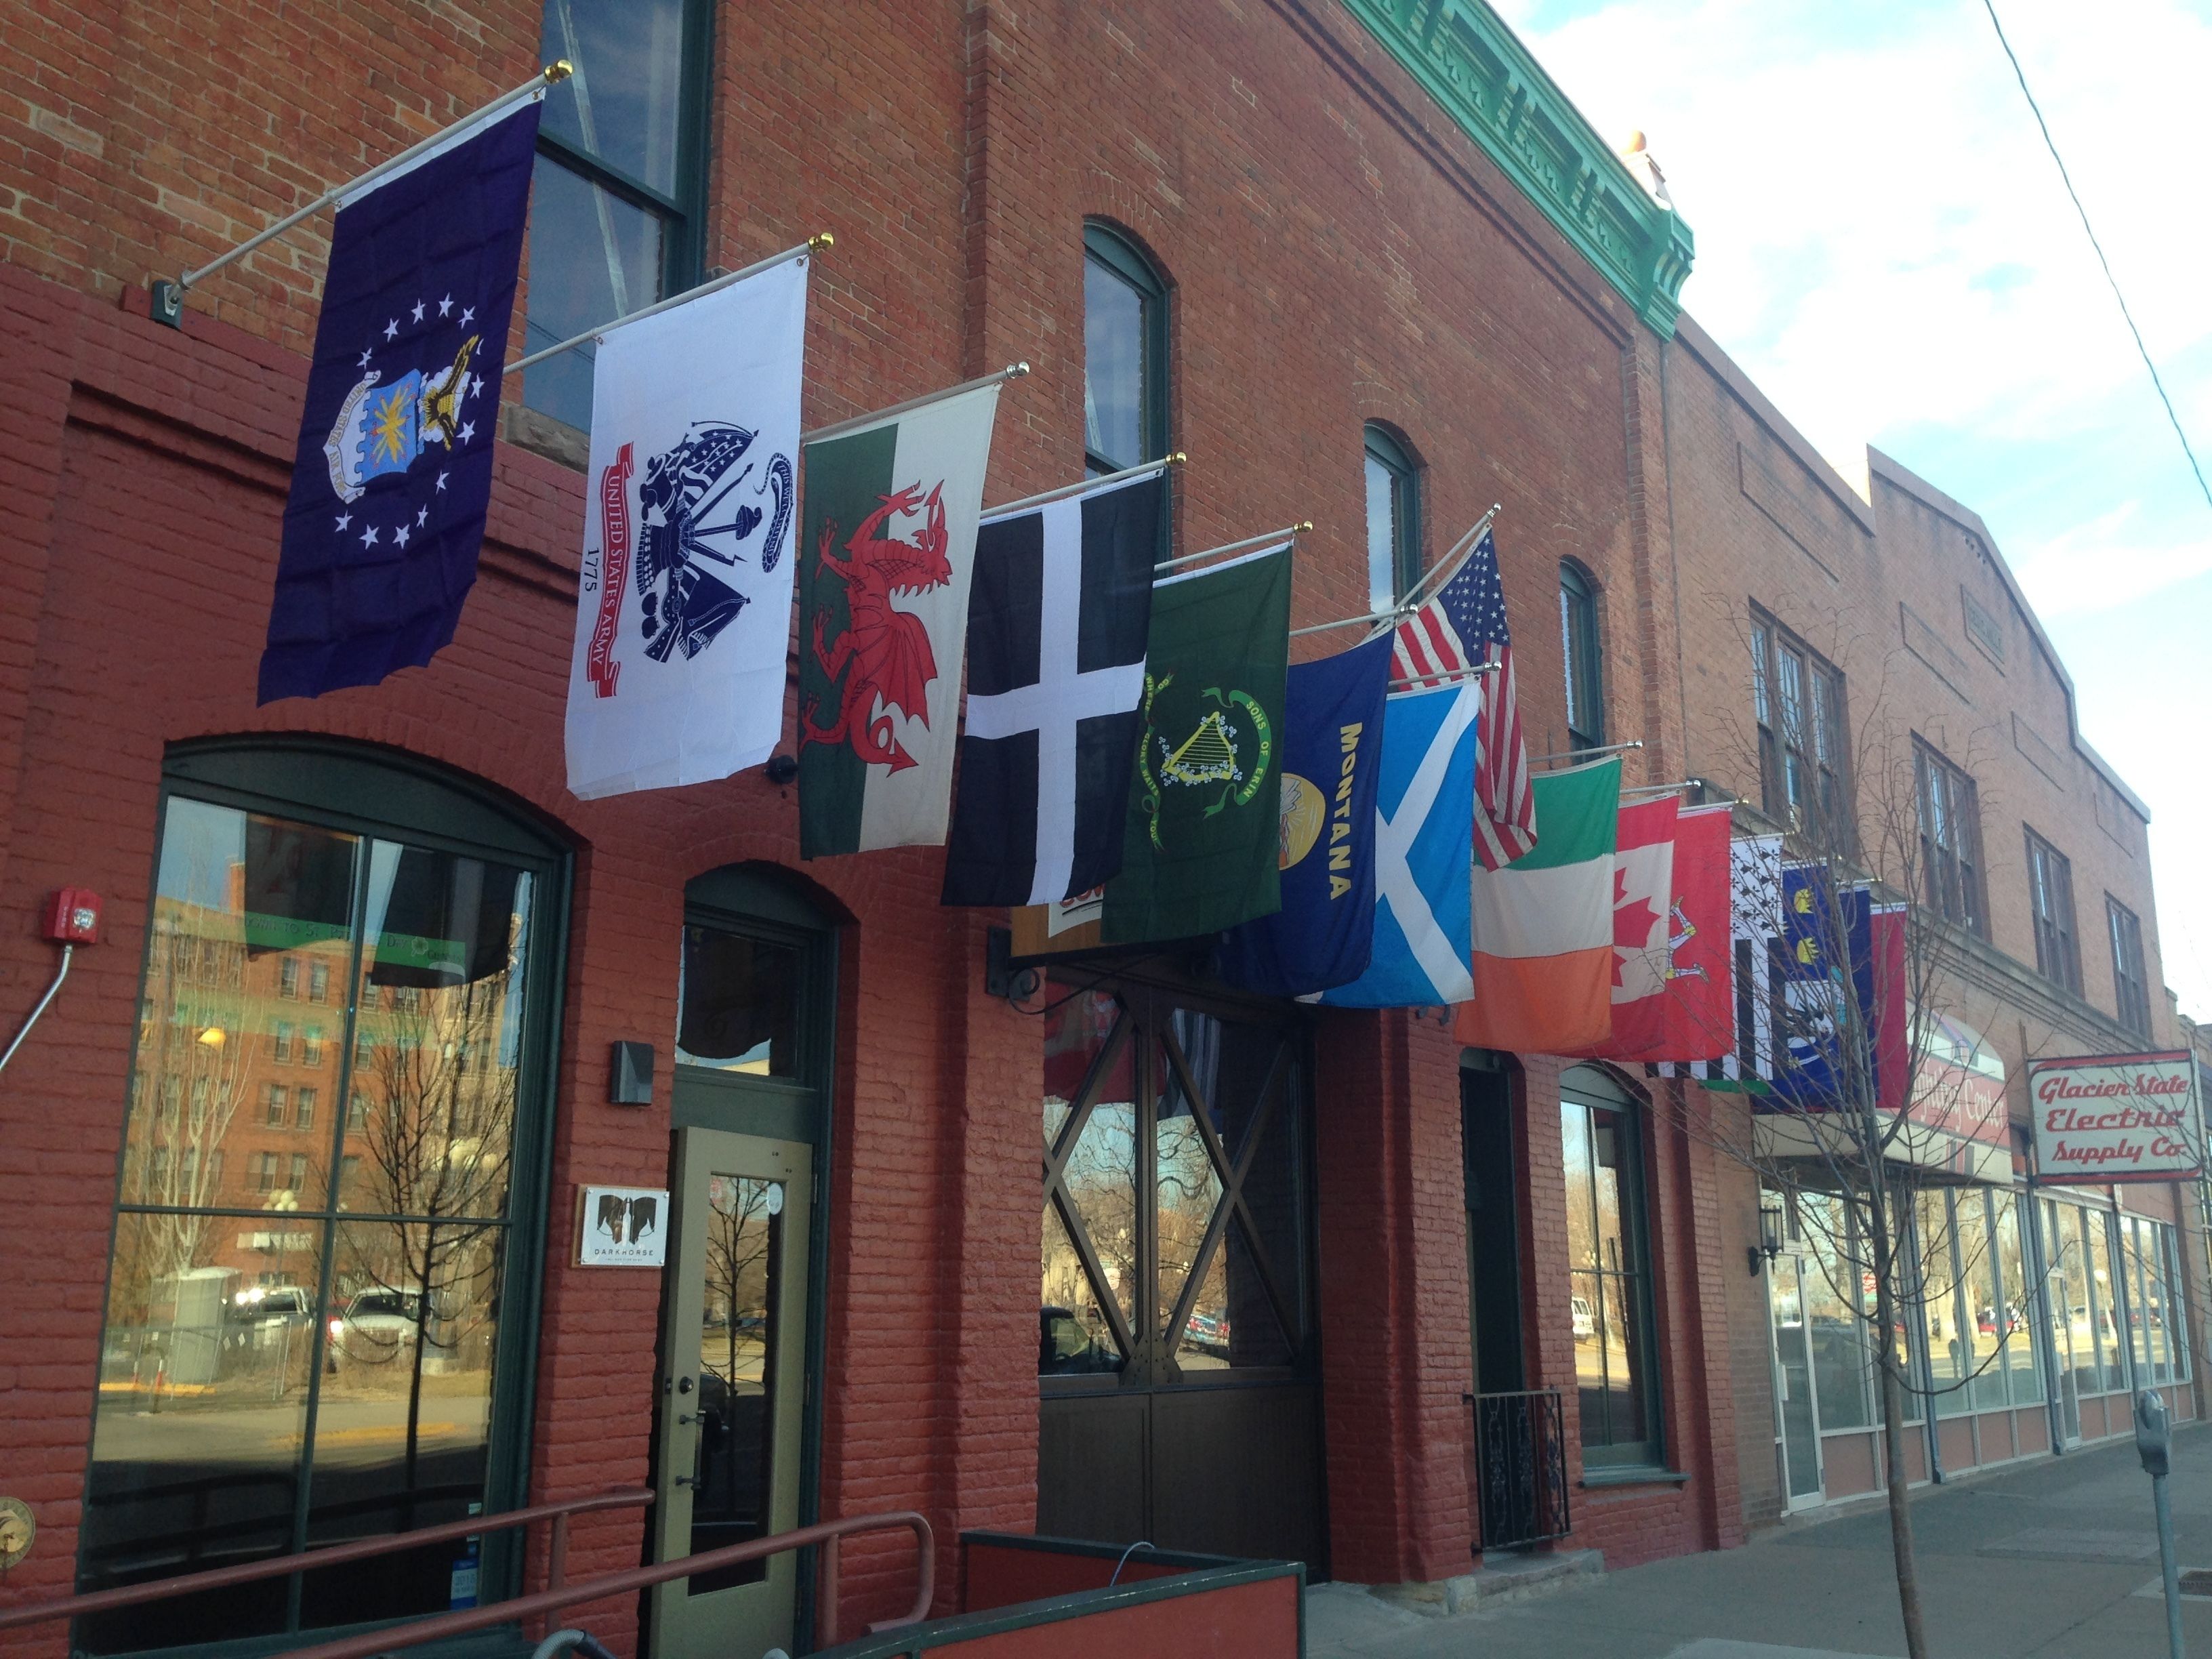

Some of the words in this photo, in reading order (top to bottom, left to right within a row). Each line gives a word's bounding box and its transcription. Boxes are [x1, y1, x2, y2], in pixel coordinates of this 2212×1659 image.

[342, 382, 368, 415] UNITED
[778, 464, 791, 483] THIS
[607, 474, 623, 544] UNITED
[583, 546, 600, 592] 1775
[605, 548, 624, 609] STATES
[592, 615, 615, 666] ARMY
[1145, 674, 1155, 712] WHERE
[1158, 678, 1170, 691] GO
[1246, 701, 1267, 730] SONS
[1140, 733, 1151, 764] GLORY
[1261, 741, 1269, 756] OF
[1142, 769, 1160, 796] WAITS
[1243, 767, 1263, 798] ERIN
[1328, 722, 1363, 901] MONTANA
[2039, 1076, 2129, 1104] Glacier
[2133, 1073, 2188, 1095] State
[2045, 1105, 2186, 1133] Electric
[2051, 1138, 2144, 1165] Supply
